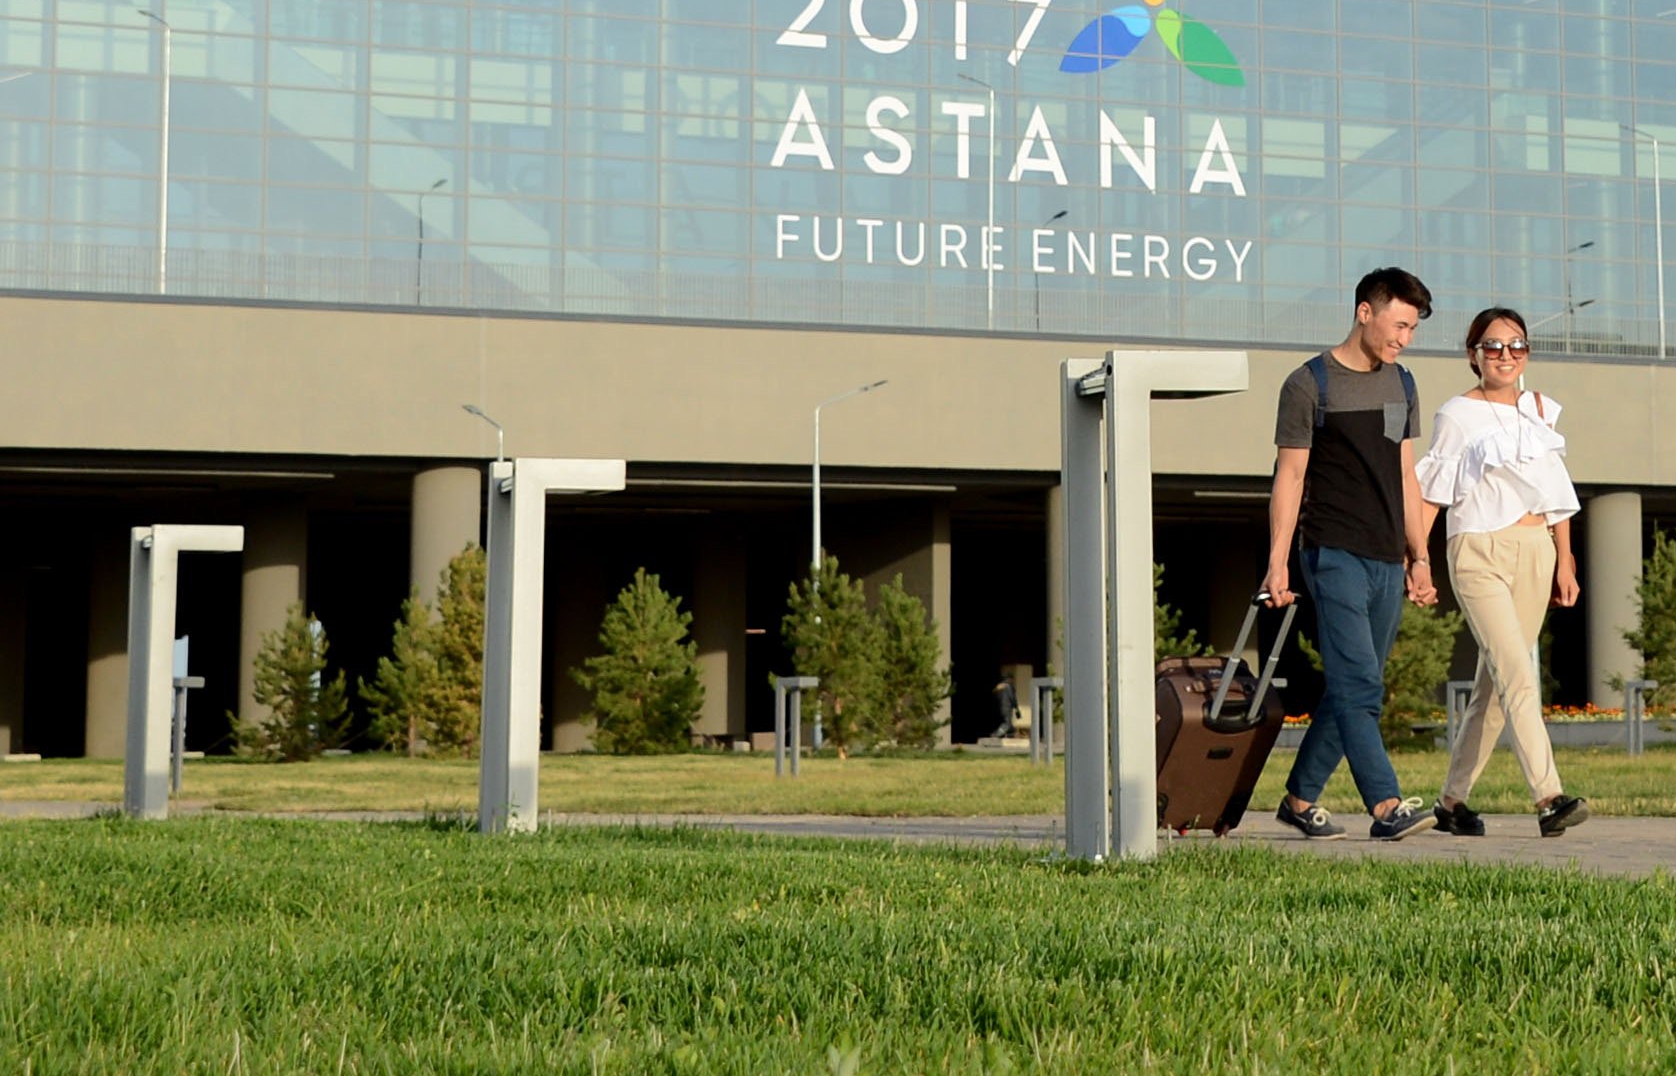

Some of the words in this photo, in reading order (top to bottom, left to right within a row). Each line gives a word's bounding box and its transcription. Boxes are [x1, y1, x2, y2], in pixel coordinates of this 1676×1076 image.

[770, 87, 1247, 197] ASTANA
[776, 215, 1005, 271] FUTURE
[1032, 229, 1252, 282] ENERGY
